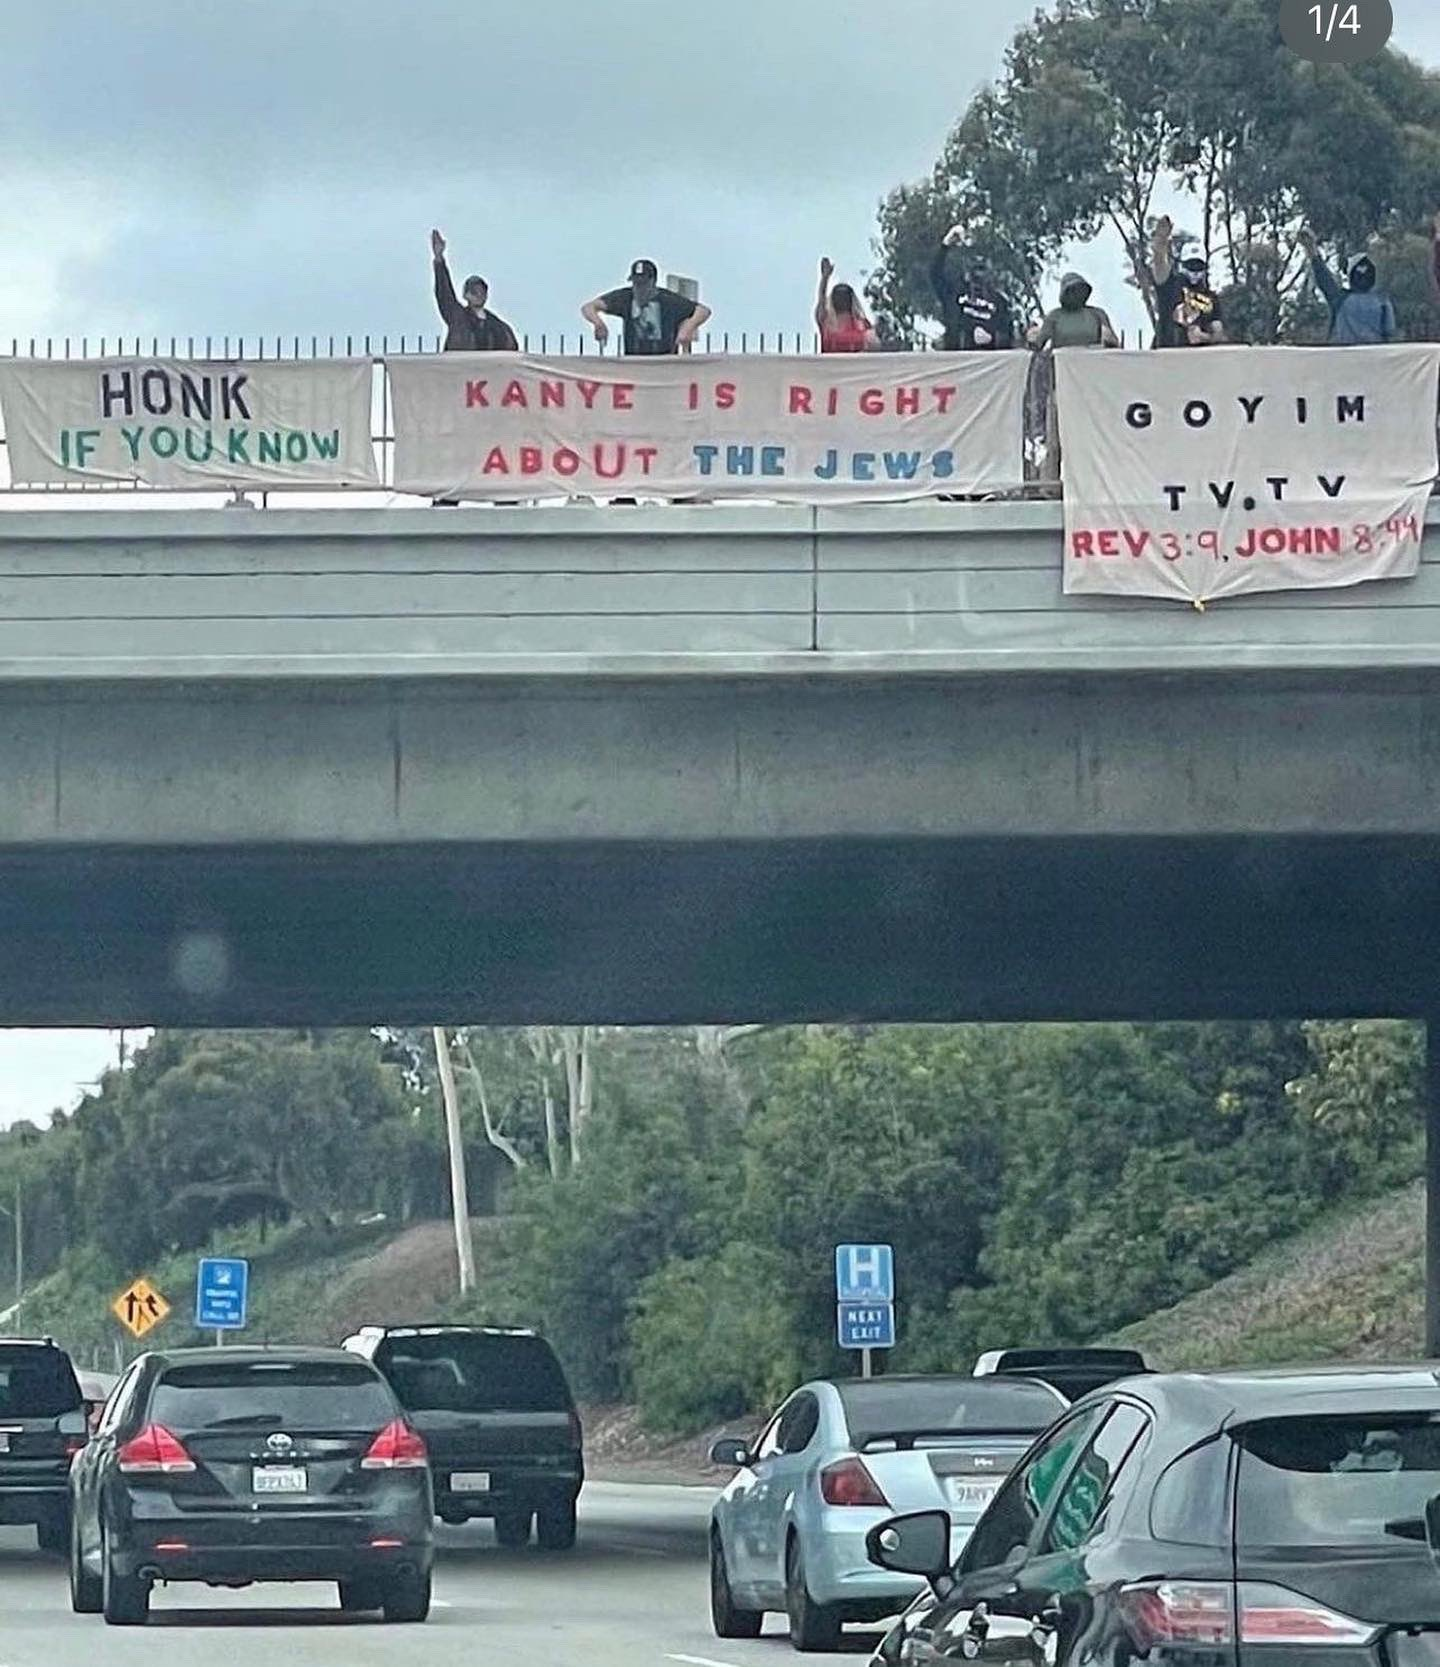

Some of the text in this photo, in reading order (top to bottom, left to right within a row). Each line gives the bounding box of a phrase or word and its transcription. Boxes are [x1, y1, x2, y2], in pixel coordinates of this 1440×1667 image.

[102, 370, 252, 420] HONK
[465, 380, 957, 415] KANYE IS RIGHT
[1125, 395, 1365, 428] GOYIM
[60, 426, 340, 467] IF YOU KNOW
[482, 443, 956, 480] ABOUT THE JEWS
[1072, 529, 1150, 558] REV
[1235, 526, 1340, 557] JOHN
[849, 1247, 880, 1287] H
[848, 1311, 882, 1323] NEXT
[851, 1327, 881, 1340] EXIT
